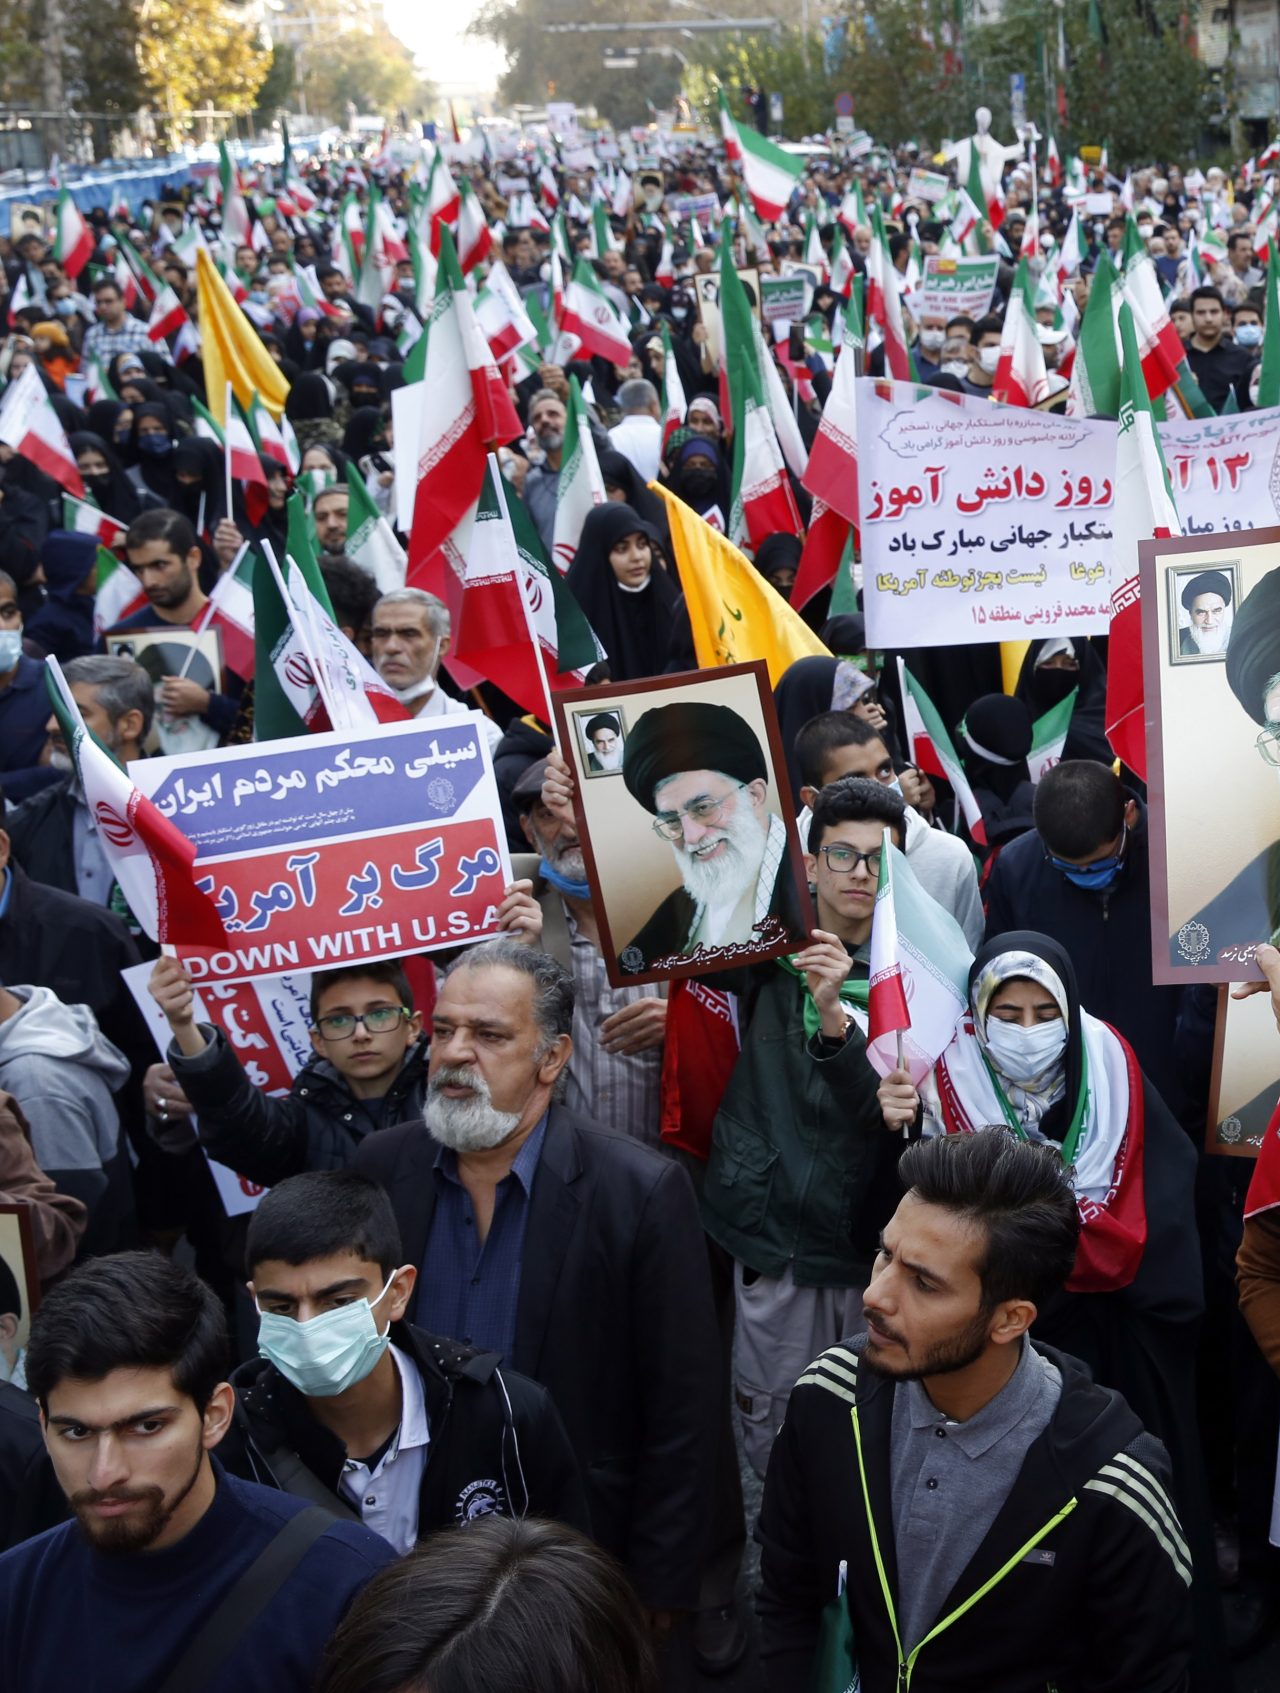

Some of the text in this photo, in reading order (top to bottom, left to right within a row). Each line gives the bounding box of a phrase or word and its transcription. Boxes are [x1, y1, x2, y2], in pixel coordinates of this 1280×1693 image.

[865, 465, 945, 520] آموز
[956, 464, 1045, 514] دانش
[1055, 469, 1113, 507] روز
[888, 533, 916, 558] باد
[921, 529, 986, 556] مبارک
[990, 523, 1052, 553] جهانی
[876, 567, 929, 596] آمریکا
[1006, 564, 1048, 588] نیست
[155, 739, 478, 817] سیلی محکم مردم ایران
[194, 837, 500, 933] مرگ بر آمری
[182, 940, 299, 979] DOWN
[307, 922, 402, 963] WITH
